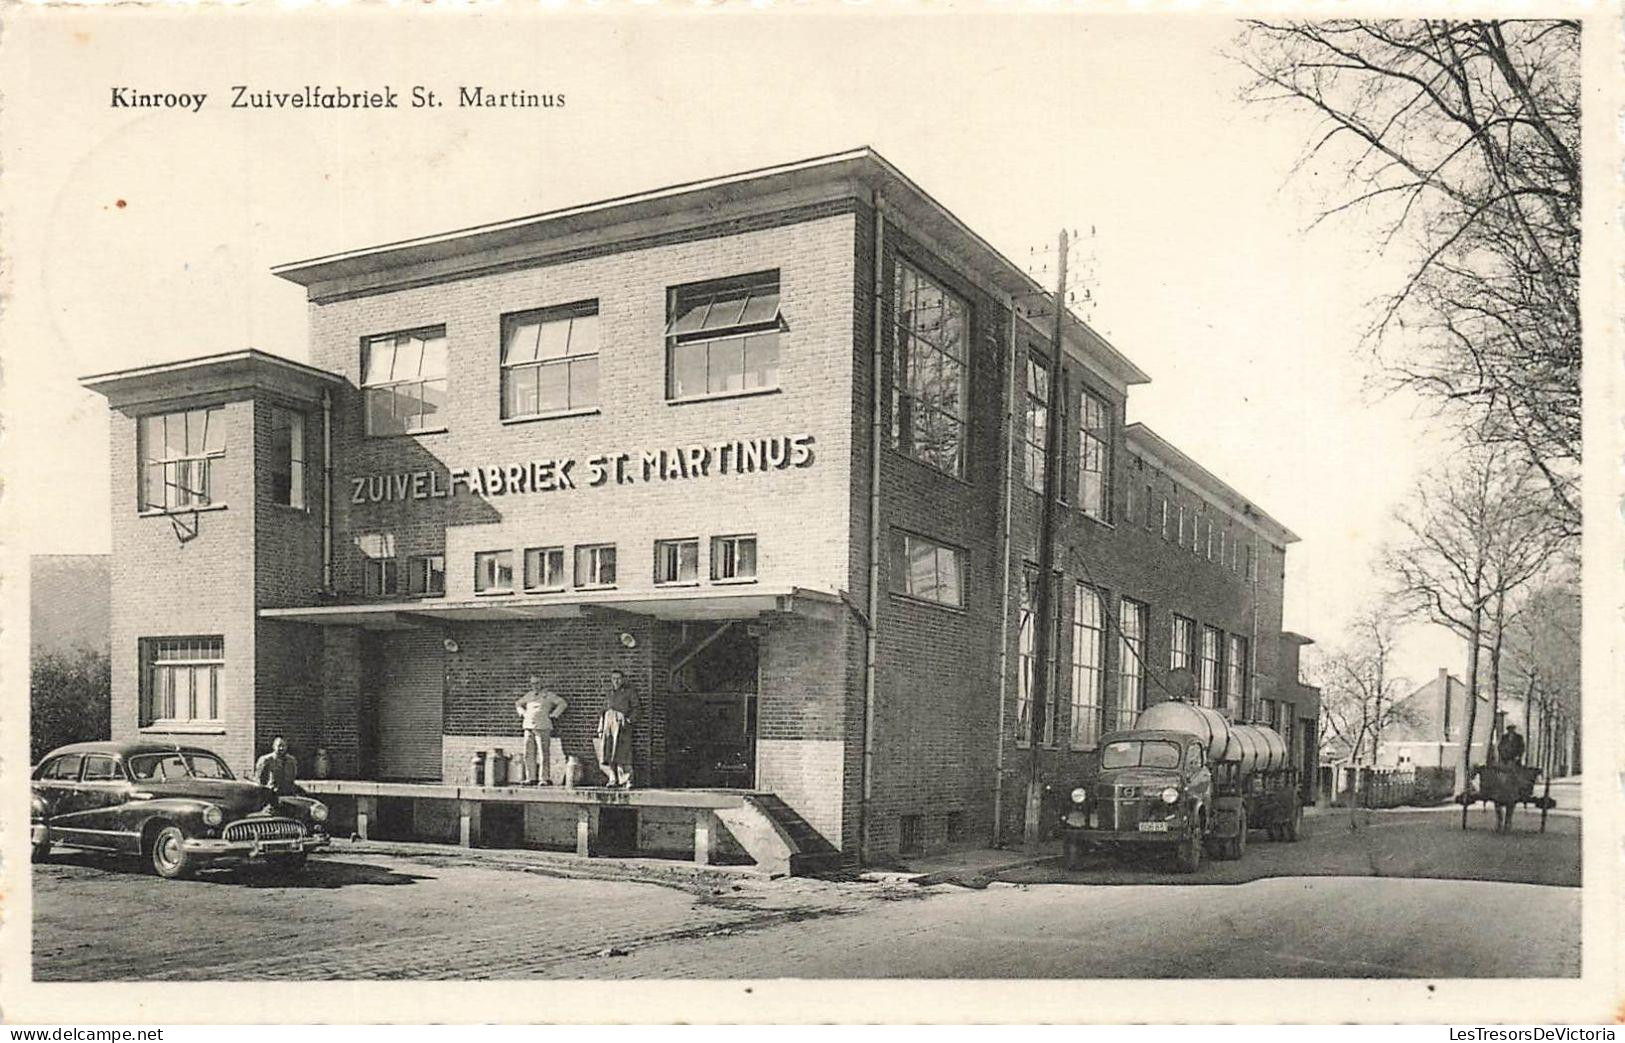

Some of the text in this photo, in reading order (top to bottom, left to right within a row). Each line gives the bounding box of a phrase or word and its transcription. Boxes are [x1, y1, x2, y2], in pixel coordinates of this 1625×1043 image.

[351, 434, 816, 505] ZUIVELFABRIEK ST. MARTINUS
